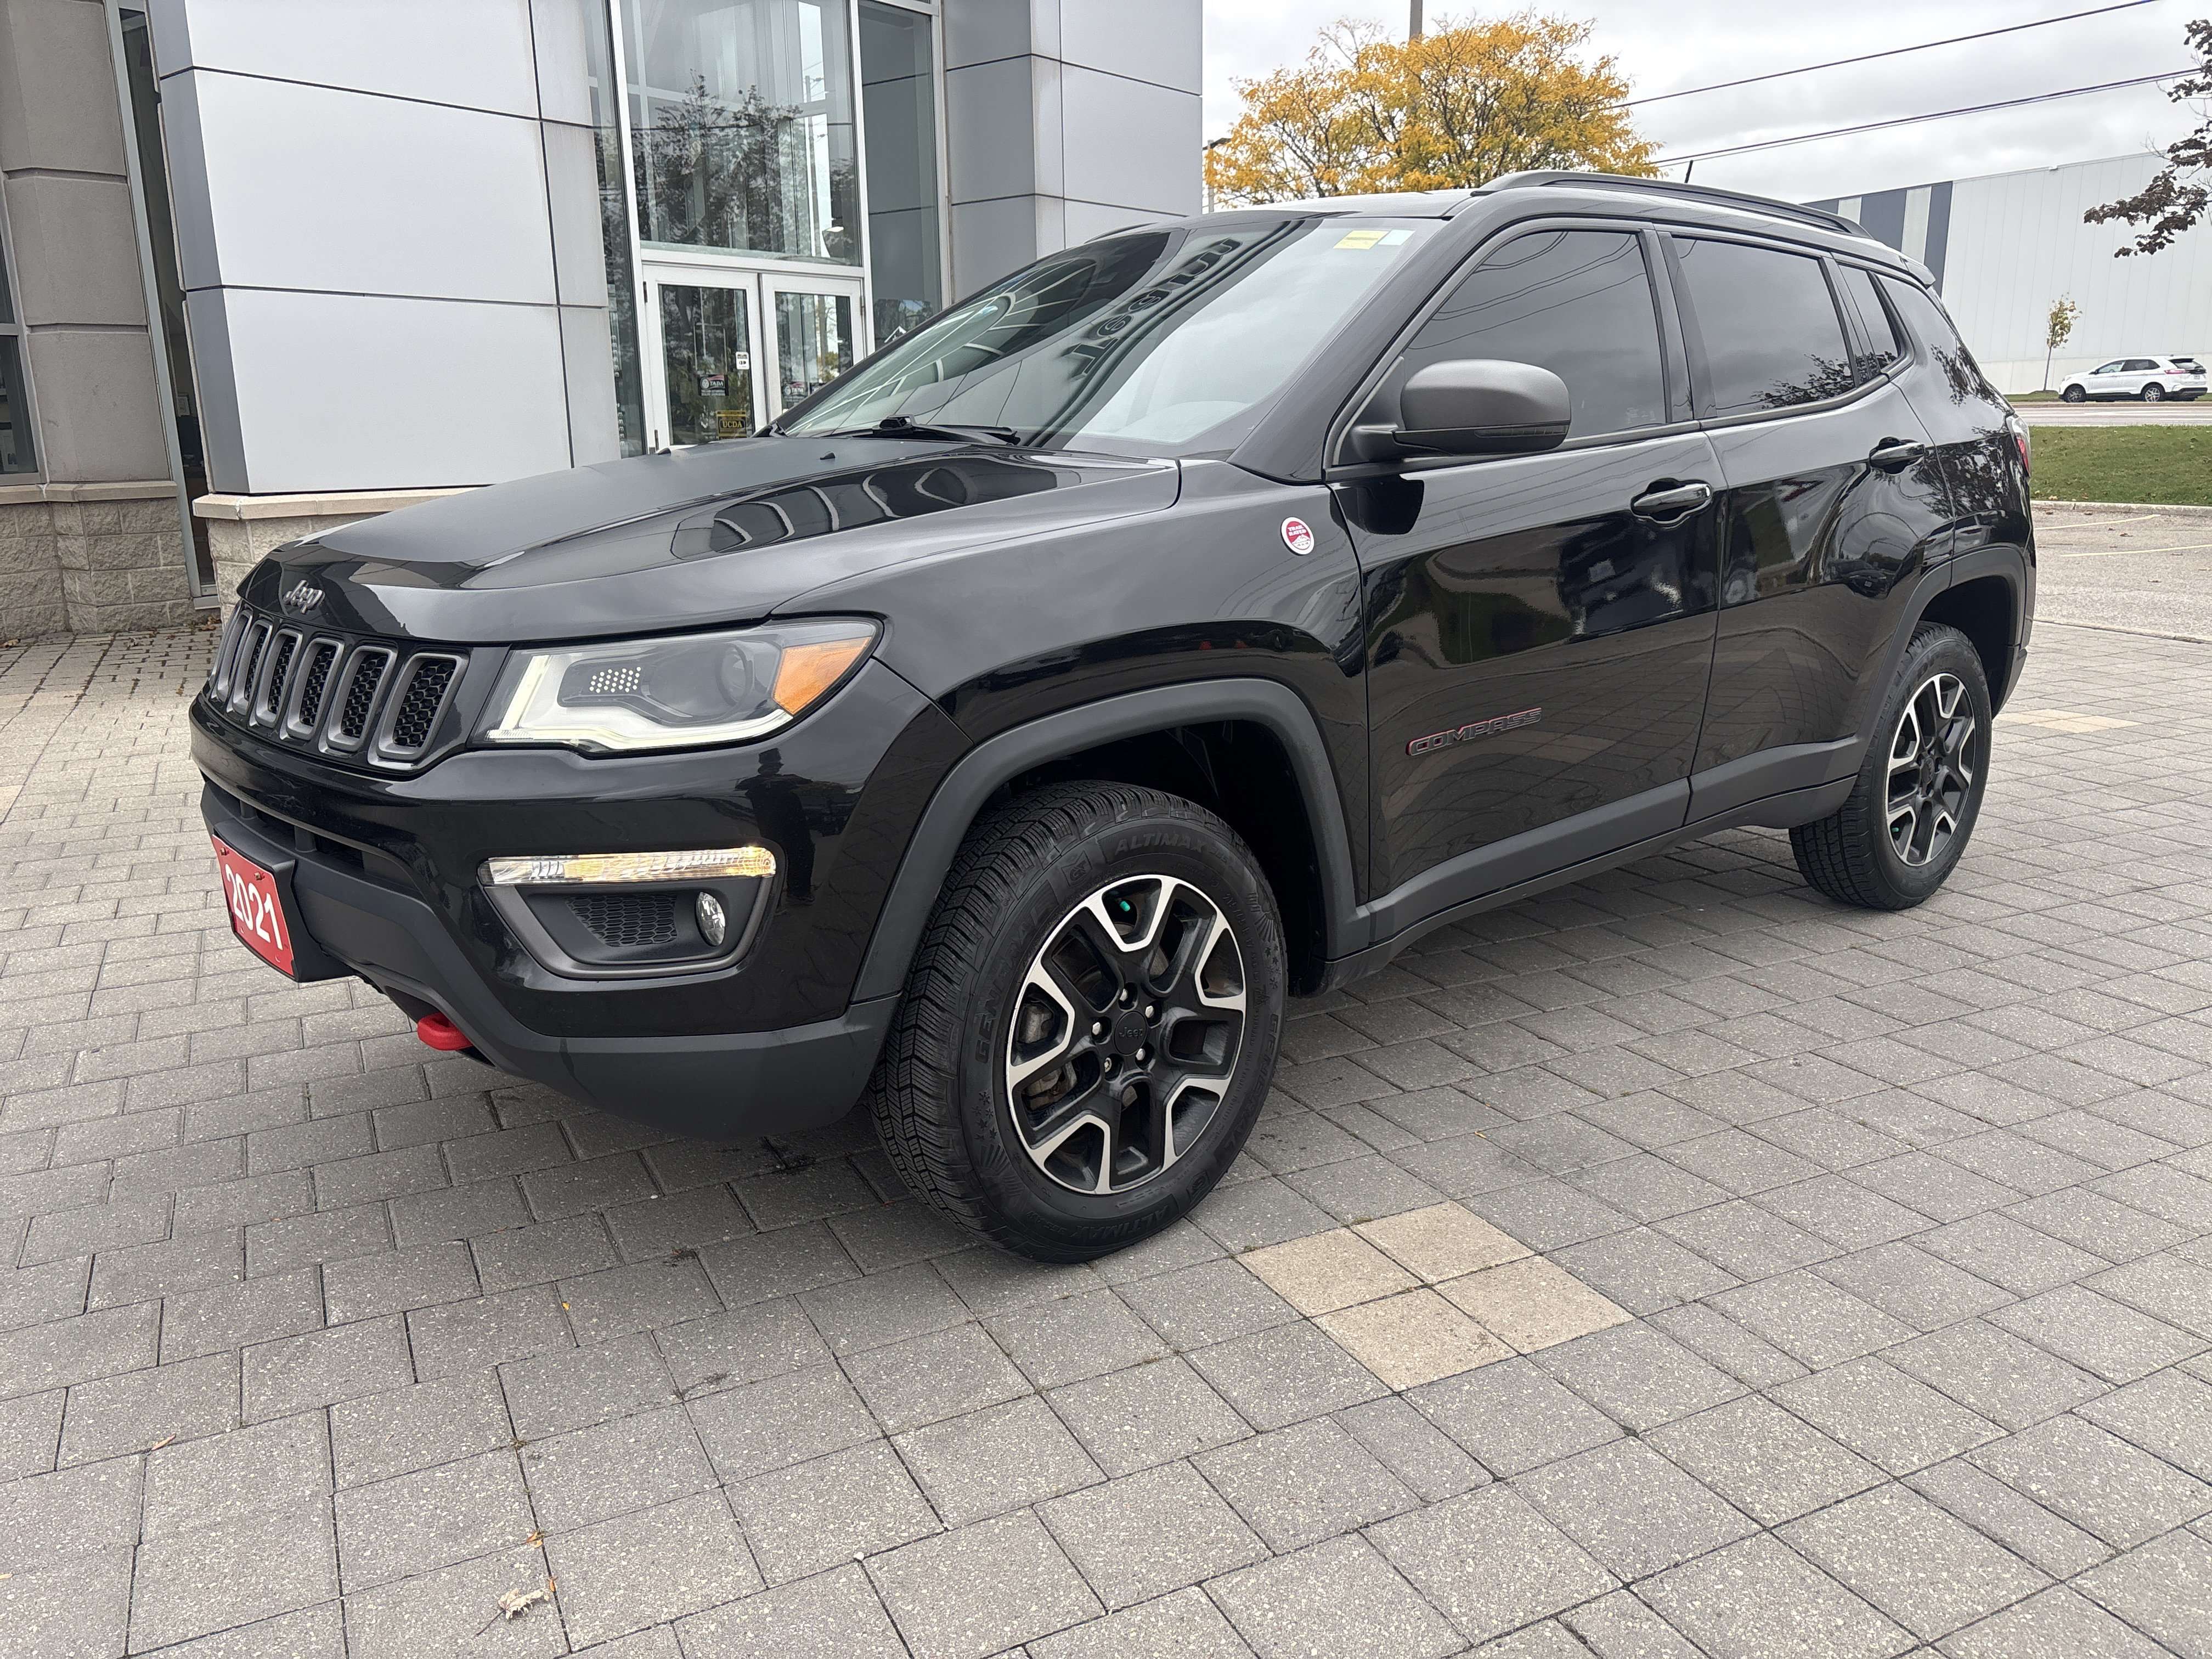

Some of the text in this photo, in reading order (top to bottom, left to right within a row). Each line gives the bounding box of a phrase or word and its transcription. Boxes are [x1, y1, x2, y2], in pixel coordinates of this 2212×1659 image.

[722, 420, 743, 428] UCDA
[283, 579, 325, 615] Jeep
[1406, 707, 1542, 757] COMPASS
[1114, 831, 1207, 856] ALTIMAX
[225, 864, 283, 951] 2021
[1119, 1026, 1143, 1039] Jeep
